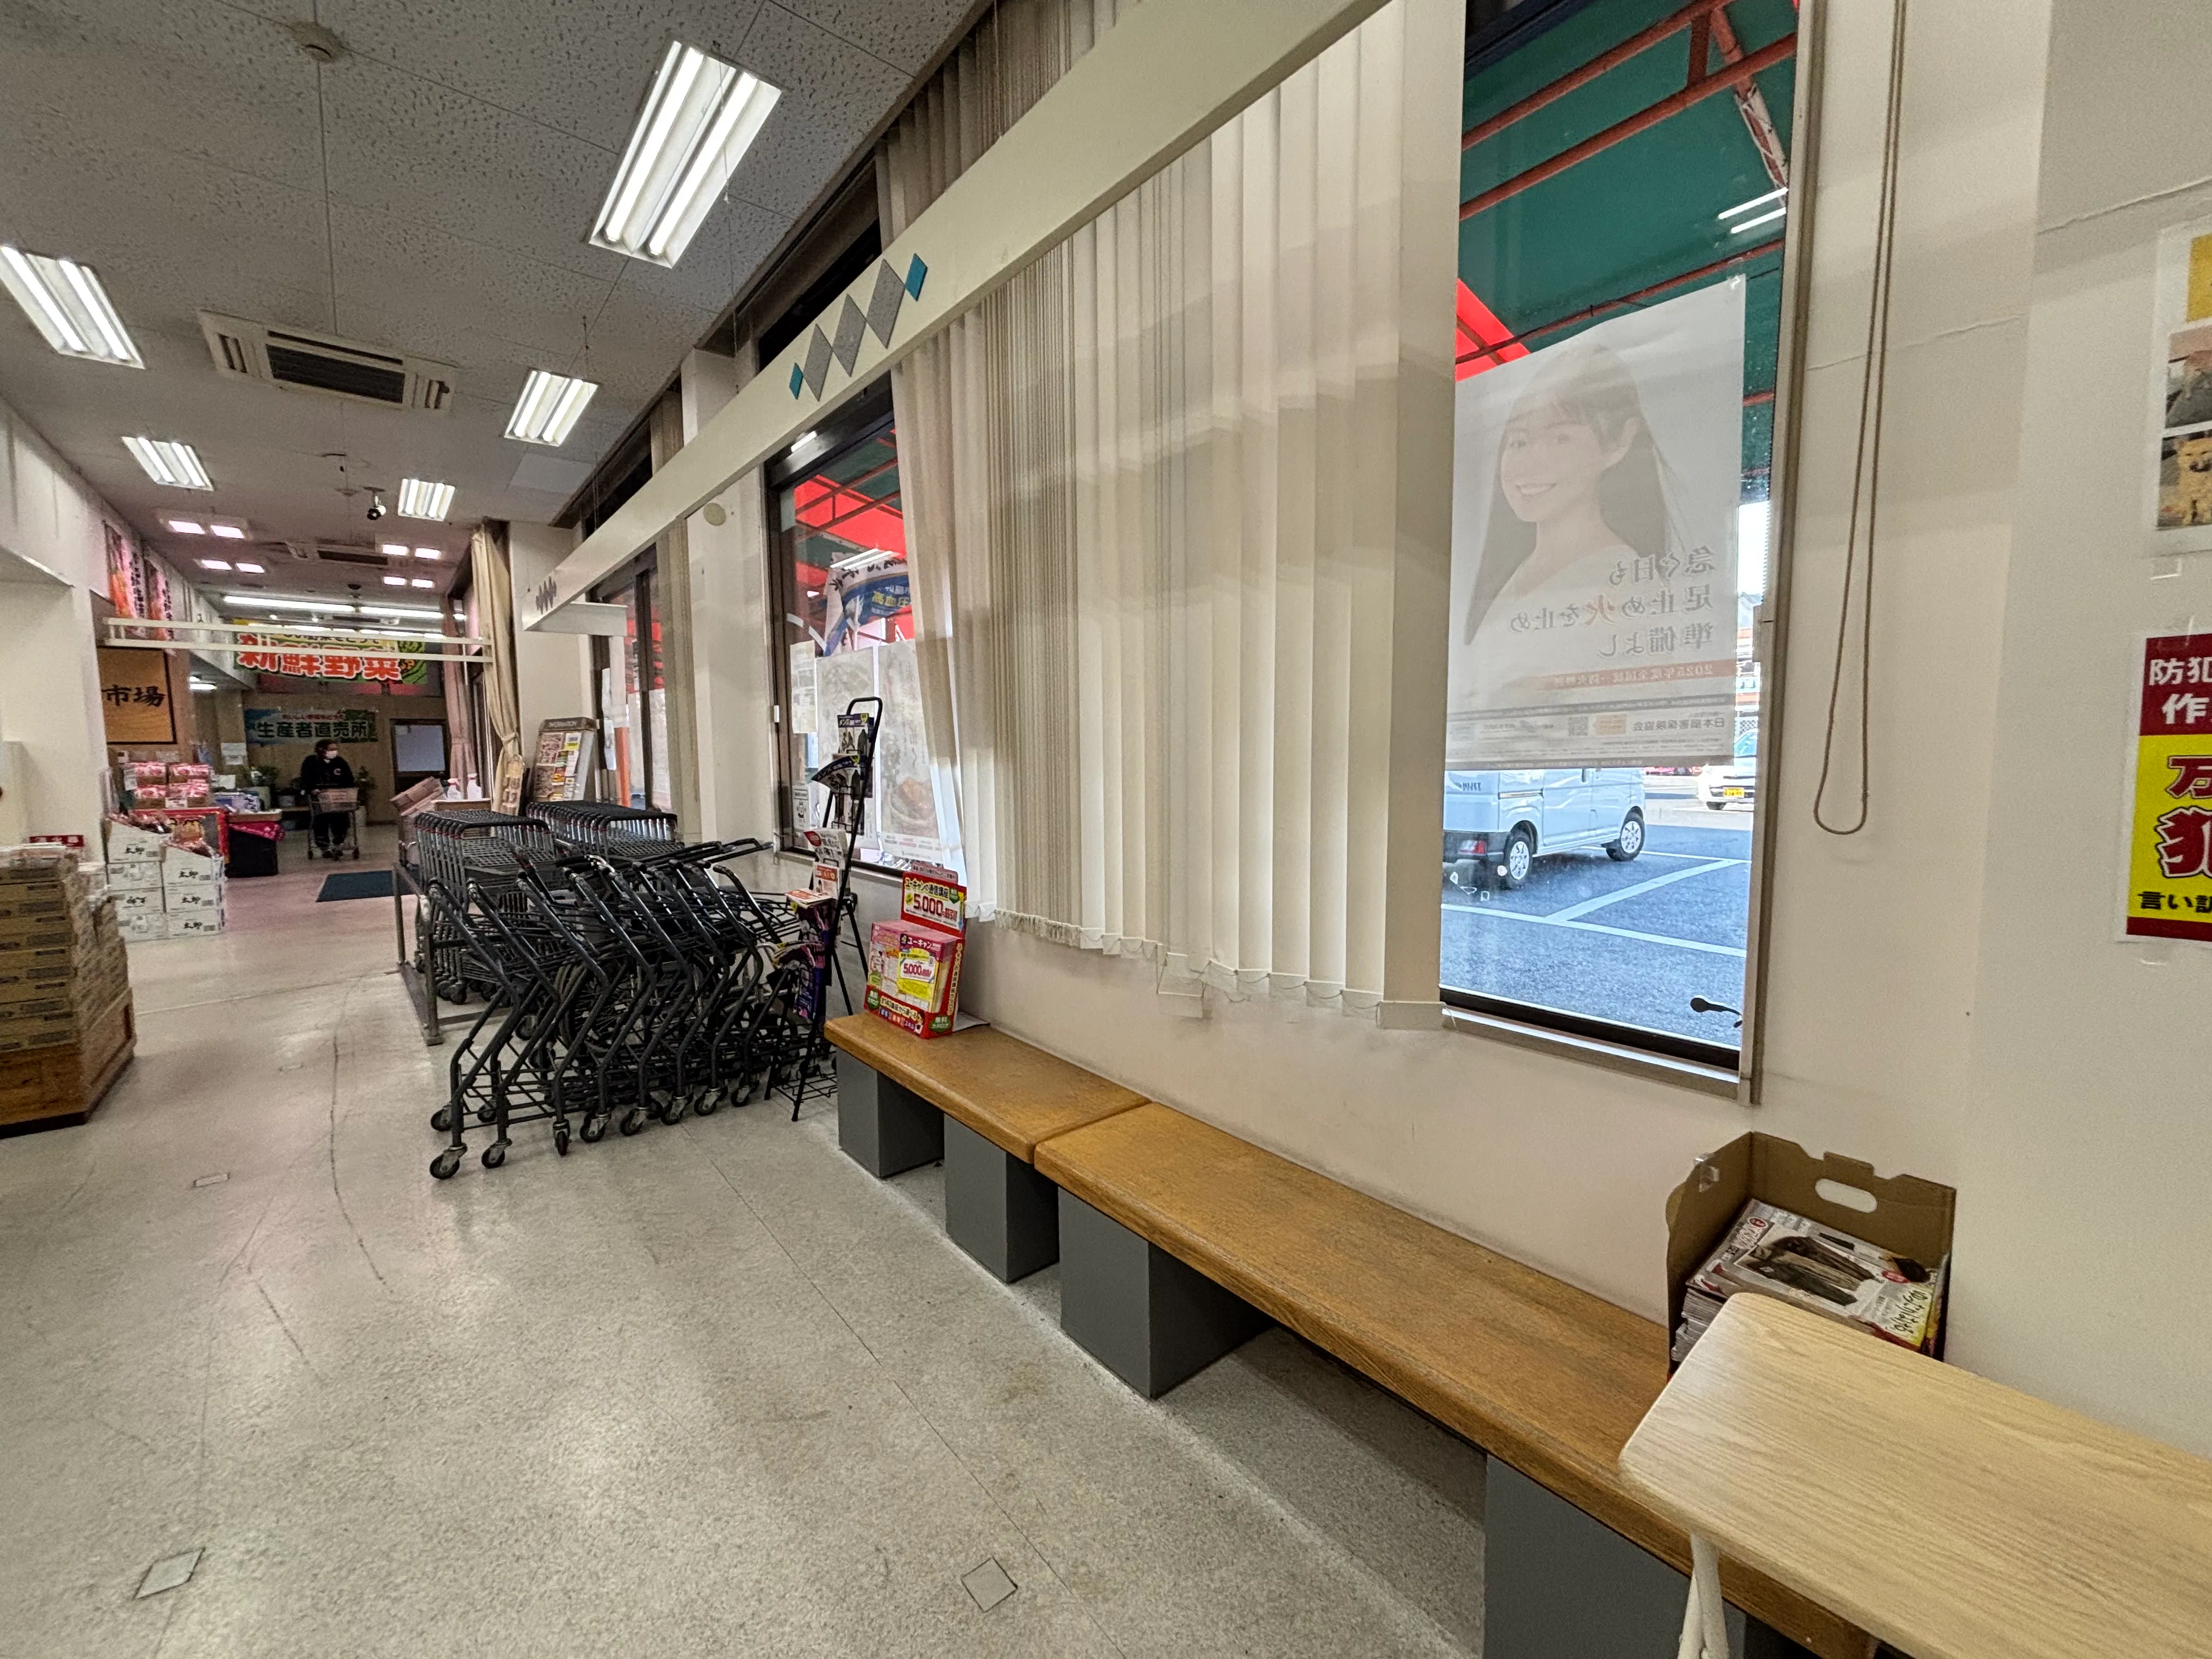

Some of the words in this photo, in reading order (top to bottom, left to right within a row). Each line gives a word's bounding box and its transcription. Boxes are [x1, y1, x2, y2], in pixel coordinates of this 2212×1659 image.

[236, 633, 402, 680] 新鮮野菜
[258, 720, 368, 739] 生産者直売所
[907, 936, 932, 949] ユーキャン
